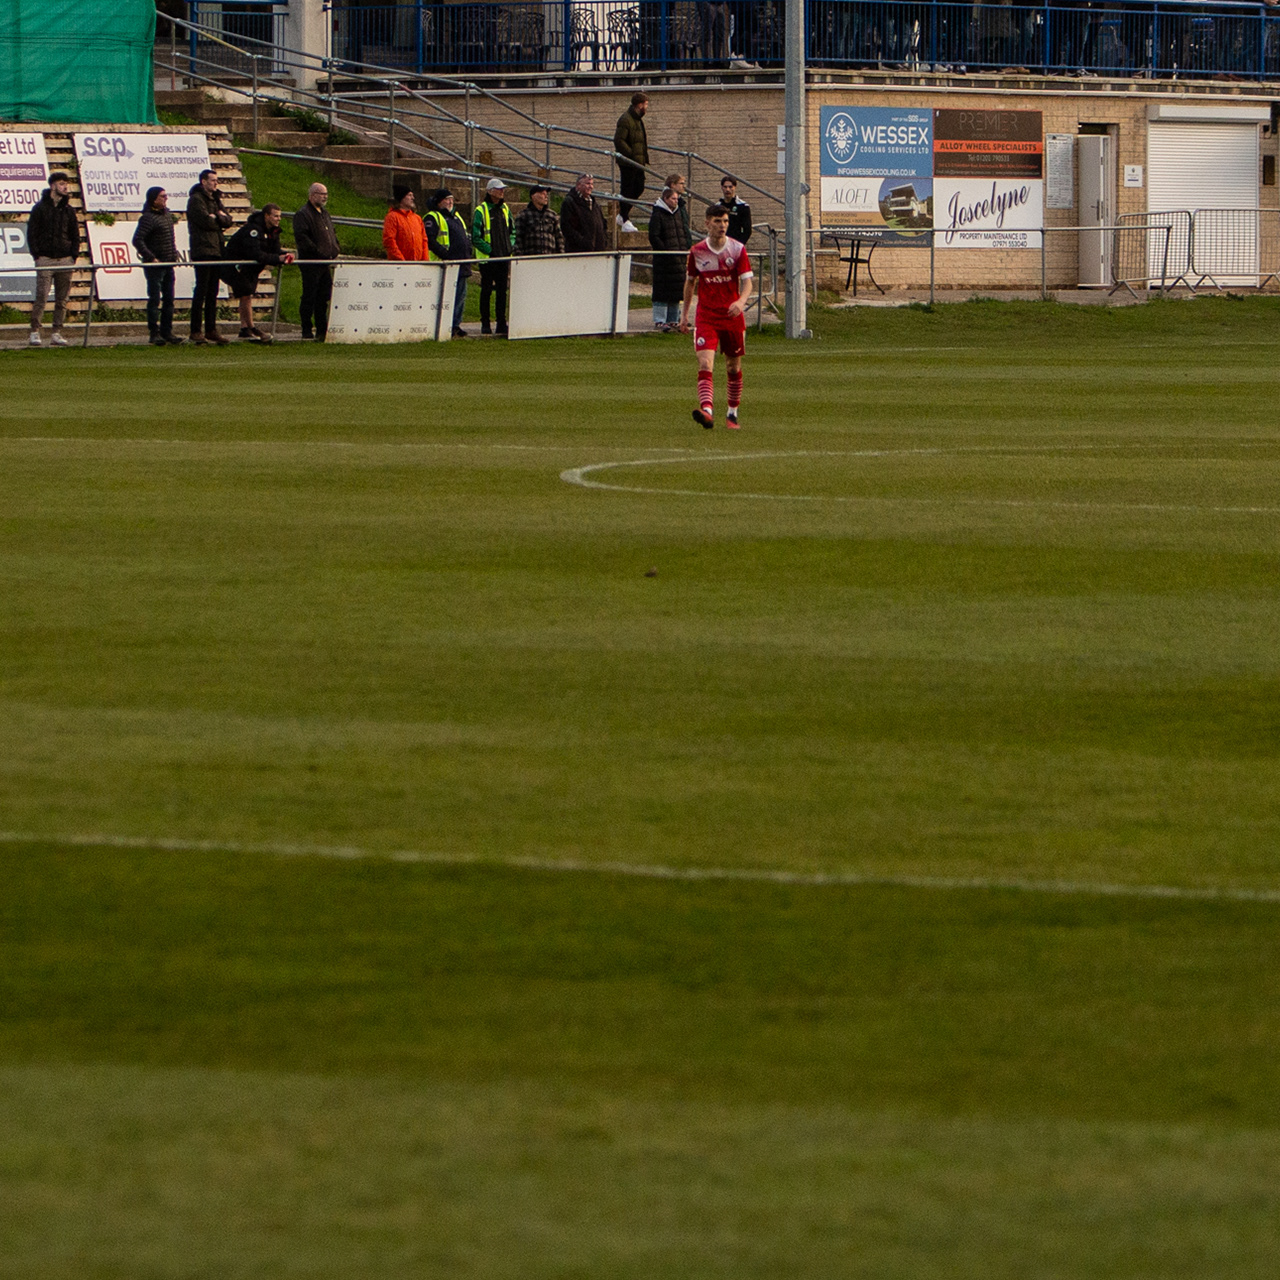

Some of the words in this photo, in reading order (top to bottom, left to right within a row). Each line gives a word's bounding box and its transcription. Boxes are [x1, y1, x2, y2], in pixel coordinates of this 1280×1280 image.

[959, 111, 1019, 131] PREMIER
[860, 125, 929, 145] WESSEX
[14, 137, 36, 155] Ltd
[83, 136, 126, 162] scp
[147, 145, 174, 153] LEADERS
[174, 145, 181, 153] IN
[182, 145, 198, 154] POST
[860, 145, 886, 153] COOLING
[888, 146, 917, 154] SERVICES
[939, 142, 964, 150] ALLOY
[965, 142, 991, 150] WHEEL
[992, 143, 1037, 151] SPECIALISTS
[141, 156, 163, 165] OFFICE
[164, 156, 208, 165] ADVERTISMENT
[84, 170, 111, 180] SOUTH
[113, 170, 138, 180] COAST
[837, 168, 917, 176] INFO@WESSEXCOOLING.CO.UK
[86, 182, 140, 196] PUBLICITY
[830, 188, 871, 204] ALOFT
[945, 180, 1031, 245] Joscelyne
[959, 232, 983, 240] PROPERTY
[984, 232, 1019, 240] MAINTENANCE
[1019, 232, 1028, 240] LTD
[992, 240, 1008, 248] 07971
[1009, 240, 1028, 248] 553040
[104, 247, 126, 265] DB
